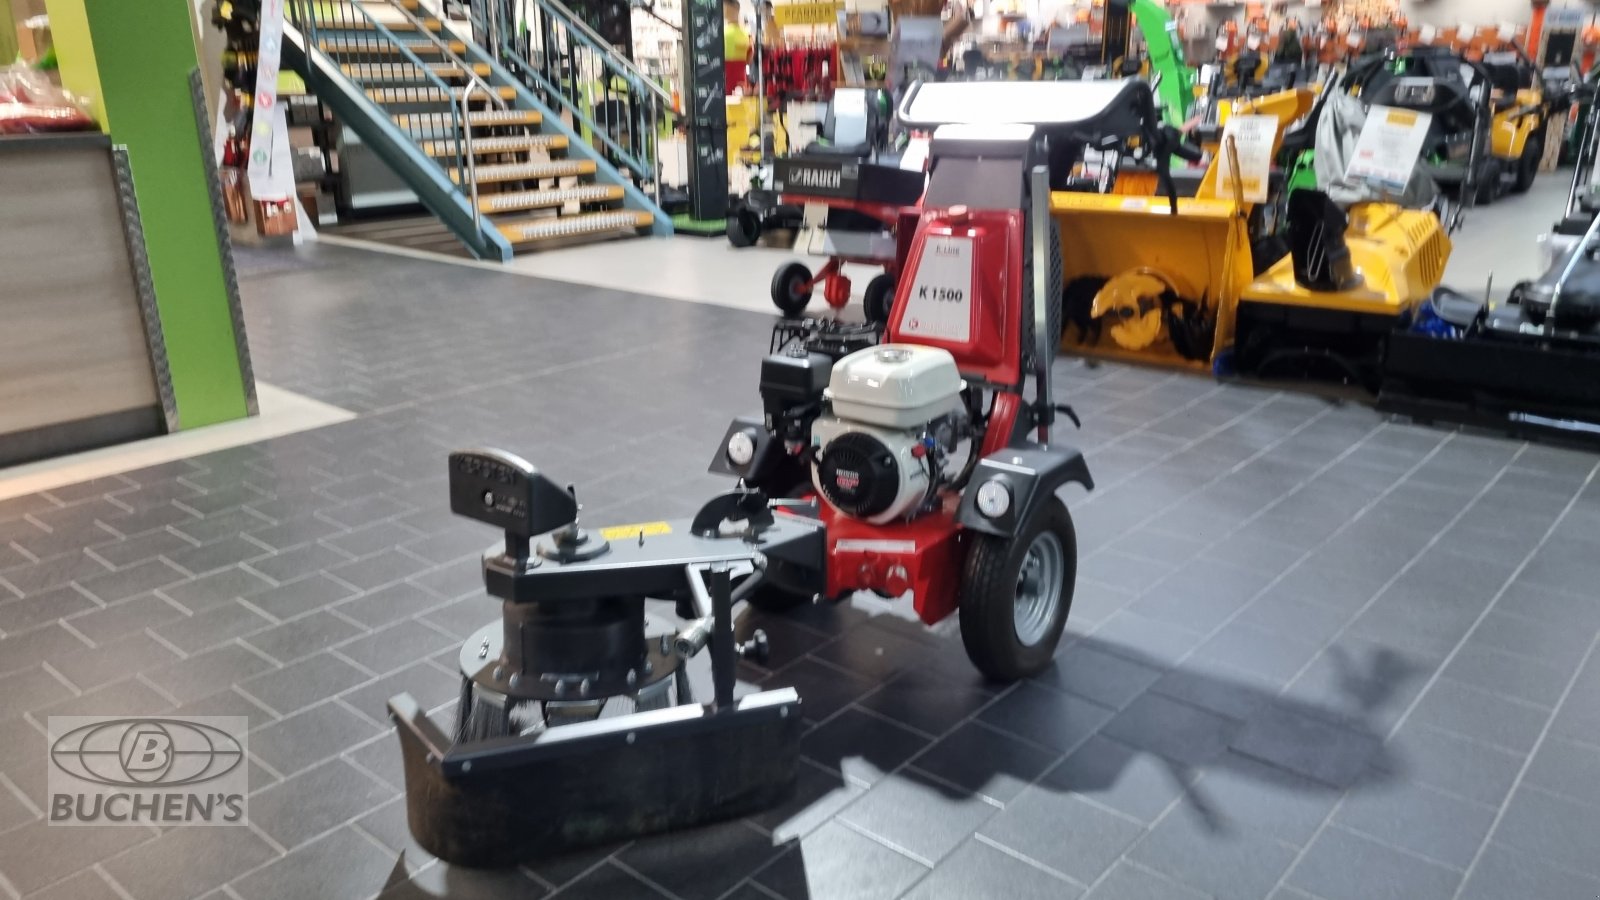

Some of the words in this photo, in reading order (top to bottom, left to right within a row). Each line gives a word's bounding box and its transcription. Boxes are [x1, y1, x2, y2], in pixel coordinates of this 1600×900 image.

[803, 167, 841, 189] RAUCH
[919, 285, 929, 300] K
[932, 286, 963, 303] 1500
